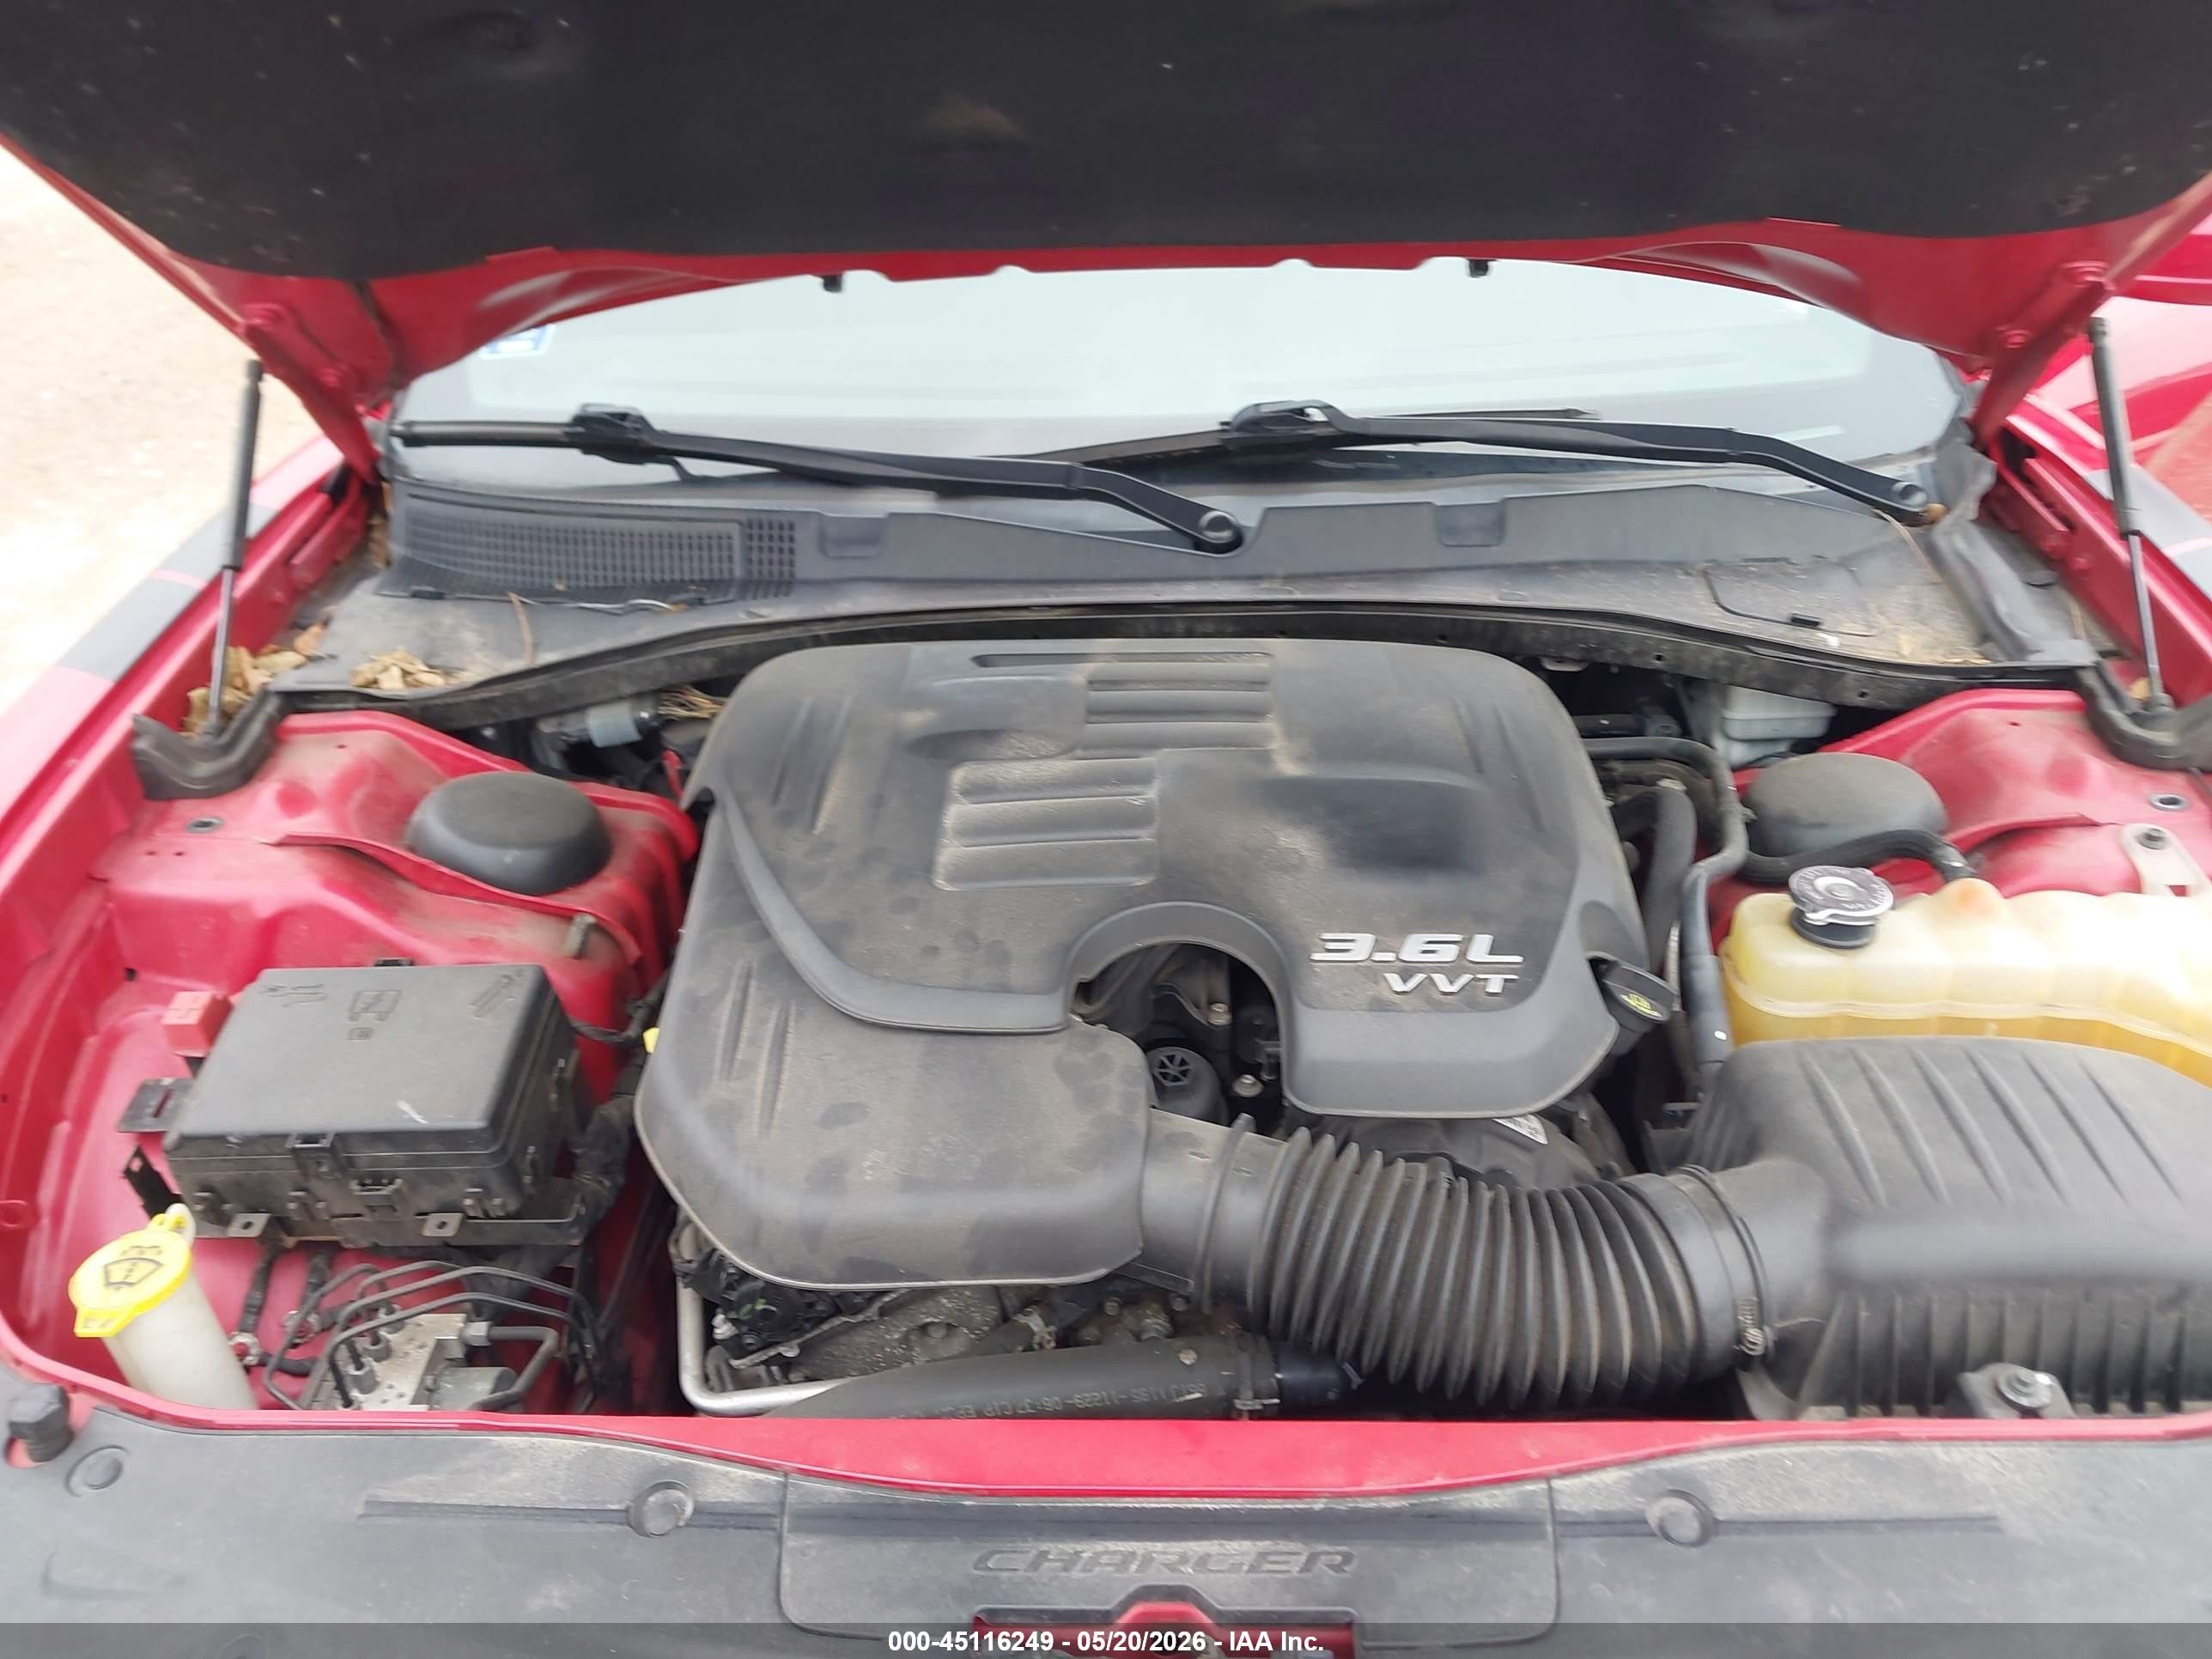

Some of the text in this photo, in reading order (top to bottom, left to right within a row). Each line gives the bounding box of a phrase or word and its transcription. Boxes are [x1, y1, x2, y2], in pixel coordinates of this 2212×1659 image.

[1310, 933, 1525, 963] 3.6L
[1383, 973, 1520, 994] VVT
[971, 1549, 1357, 1575] CHARGER
